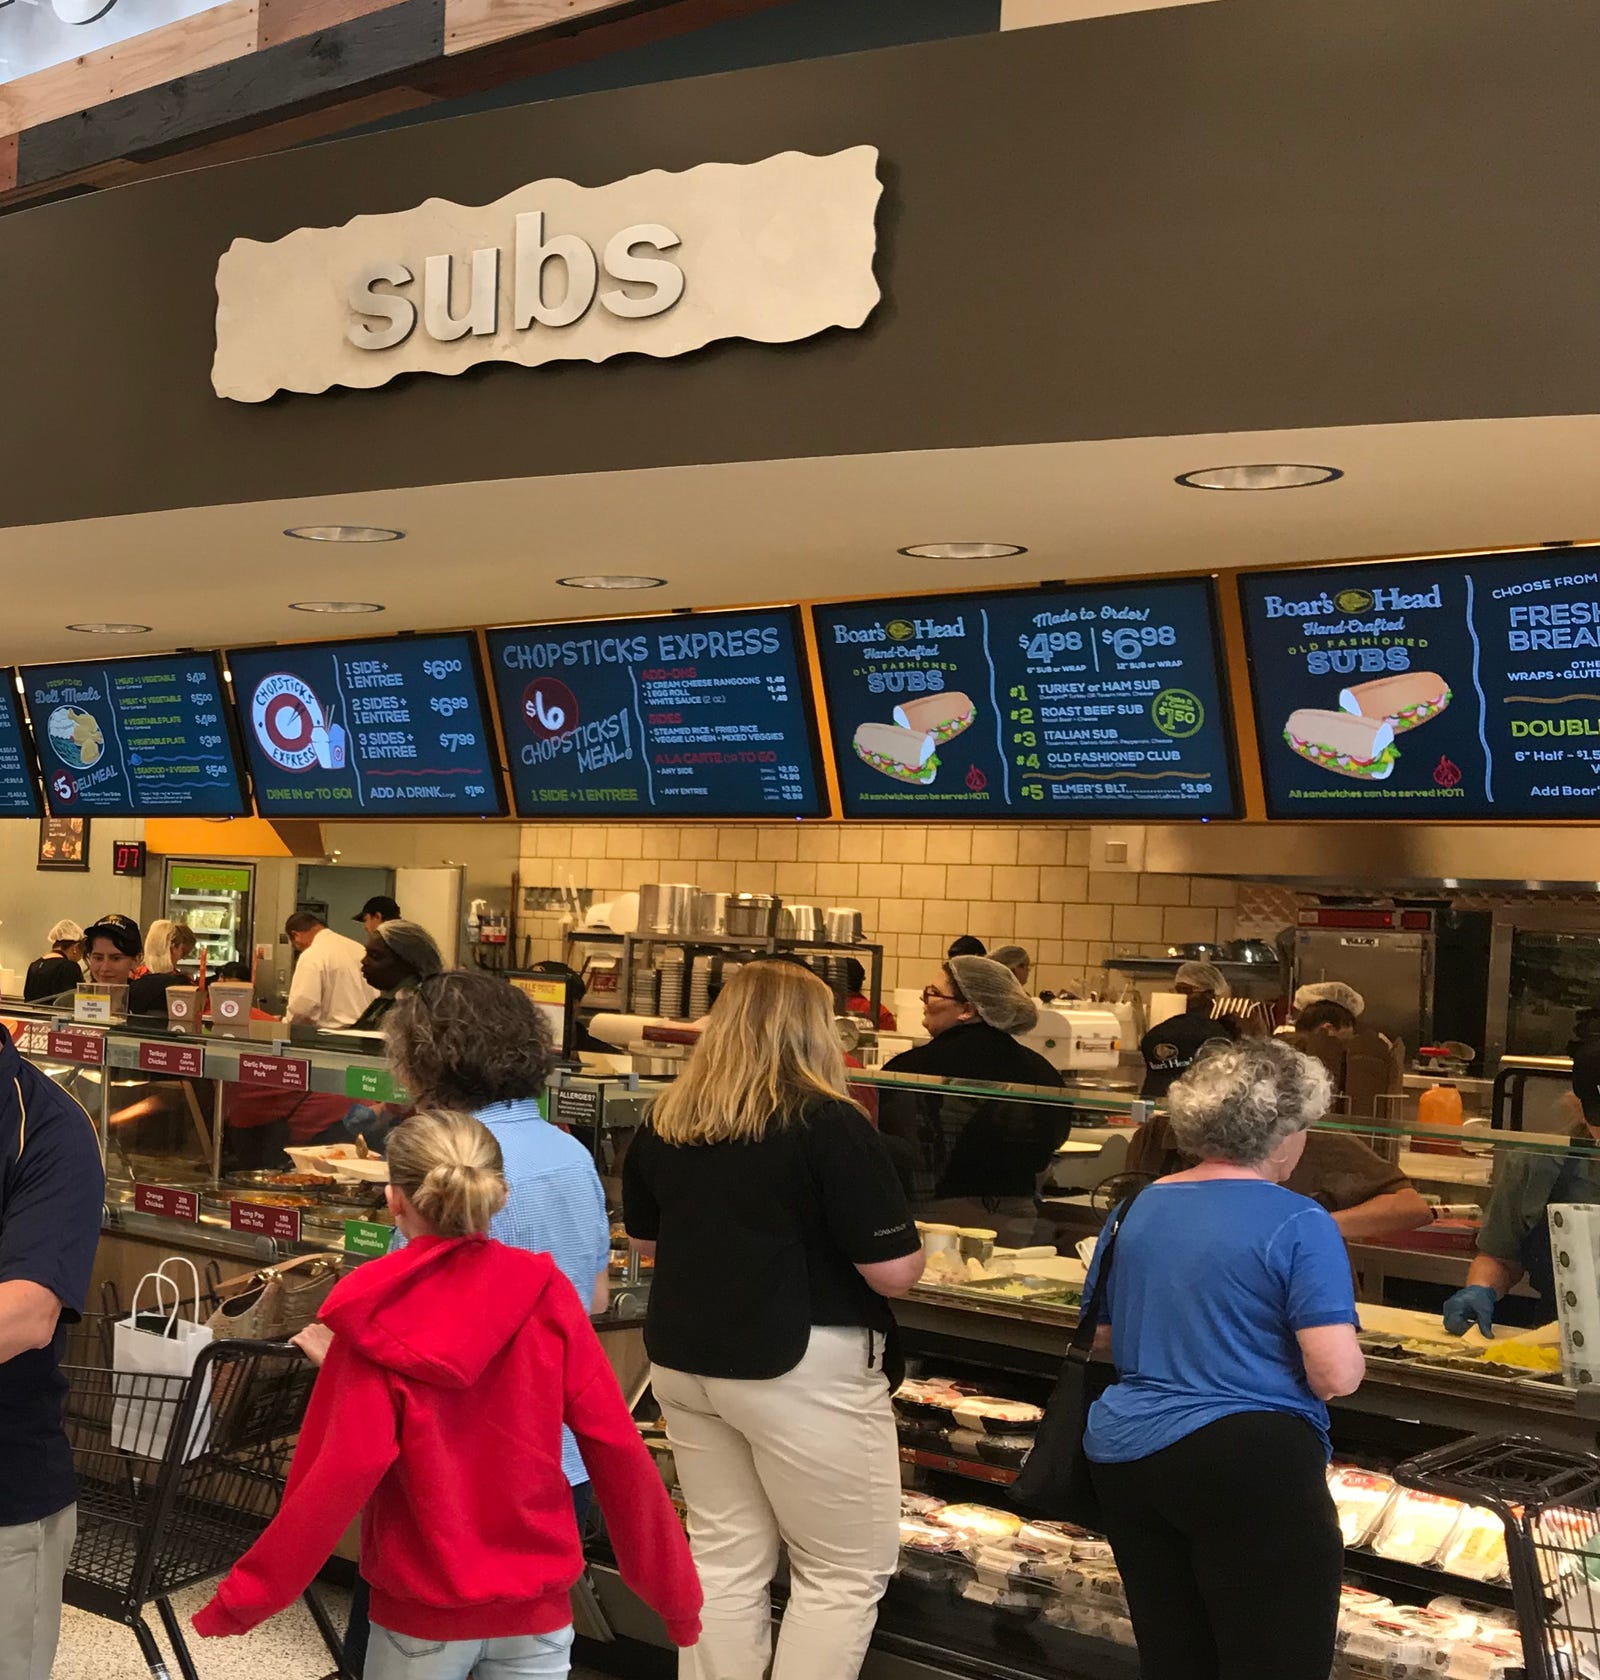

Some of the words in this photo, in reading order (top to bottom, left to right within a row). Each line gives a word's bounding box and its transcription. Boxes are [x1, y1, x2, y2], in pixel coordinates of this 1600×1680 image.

[347, 212, 685, 350] subs
[1492, 579, 1551, 599] CHOOSE
[1554, 573, 1598, 588] FROM
[1264, 592, 1334, 618] Boar's
[1372, 584, 1443, 612] Head
[1033, 609, 1078, 628] Made
[1080, 607, 1096, 621] to
[1100, 606, 1150, 622] Order!
[833, 622, 886, 644] Boar's
[913, 616, 966, 639] Head
[1302, 617, 1405, 636] Hand-Crafted
[1508, 626, 1600, 651] BREA
[503, 636, 648, 669] CHOPSTICKS
[658, 628, 780, 661] EXPRESS
[863, 643, 940, 660] Hand-Crafted
[1288, 643, 1319, 655] OLD
[1327, 637, 1429, 648] FASHIONED
[352, 661, 379, 674] SIDE
[1156, 660, 1183, 668] WRAP
[1307, 647, 1410, 675] SUBS
[642, 668, 697, 680] ADD-ONS
[852, 665, 876, 676] OLD
[882, 661, 957, 671] FASHIONED
[1061, 665, 1087, 673] WRAP
[355, 673, 403, 688] ENTREE
[653, 680, 682, 689] CREAM
[683, 679, 712, 687] CHEESE
[714, 677, 761, 686] RANGOONS
[867, 670, 945, 693] SUBS
[1507, 671, 1554, 681] WRAPS
[35, 690, 60, 704] Deli
[62, 687, 101, 703] Meals
[1010, 685, 1028, 701] #1
[1037, 683, 1085, 695] TURKEY
[1102, 681, 1132, 691] HAM
[1134, 680, 1160, 690] SUB
[352, 699, 362, 711] 2
[364, 697, 398, 710] SIDES
[649, 697, 674, 705] WHITE
[675, 696, 702, 704] SAUCE
[361, 710, 410, 724] ENTREE
[526, 691, 565, 730] $6
[1010, 708, 1034, 724] #2
[1041, 706, 1082, 717] ROAST
[1084, 705, 1115, 716] BEEF
[1117, 704, 1144, 715] SUB
[648, 713, 682, 724] SIDES
[653, 727, 690, 735] STEAMED
[692, 726, 709, 734] RICE
[740, 725, 758, 733] RICE
[1511, 719, 1600, 737] DOUBL
[359, 733, 368, 745] 3
[370, 733, 405, 745] SIDES
[521, 713, 620, 766] CHOPSTICKS
[721, 734, 747, 742] MIXED
[749, 732, 784, 741] VEGGIES
[1013, 731, 1037, 747] #3
[1044, 729, 1090, 740] ITALIAN
[1092, 729, 1118, 739] SUB
[273, 743, 315, 766] EXPRESS
[368, 746, 417, 759] ENTREE
[757, 751, 777, 762] GO
[1534, 750, 1564, 761] Half
[1016, 754, 1040, 769] #4
[1047, 753, 1072, 763] OLD
[1074, 751, 1145, 762] FASHIONED
[1147, 751, 1180, 761] CLUB
[54, 776, 71, 799] $5
[72, 776, 91, 792] DELI
[92, 766, 118, 786] MEAL
[267, 788, 292, 799] DINE
[293, 788, 303, 799] IN
[315, 788, 331, 799] TO
[370, 787, 394, 799] ADD
[396, 787, 406, 798] A
[406, 786, 443, 798] DRINK
[537, 789, 569, 801] SIDE
[585, 788, 638, 801] ENTREE
[1021, 784, 1044, 800] #5
[1052, 784, 1102, 794] ELMER'S
[1303, 789, 1361, 798] sandwiches
[1383, 789, 1397, 797] be
[1398, 789, 1436, 798] served
[1530, 785, 1560, 796] Add
[117, 848, 139, 868] 07
[243, 1060, 258, 1069] Garlic
[259, 1062, 277, 1071] Pepper
[362, 1075, 376, 1083] Fried
[559, 1091, 596, 1101] ALLERGIES?
[253, 1211, 265, 1220] Pao
[360, 1229, 377, 1239] Mixed
[353, 1236, 384, 1249] Vegetables
